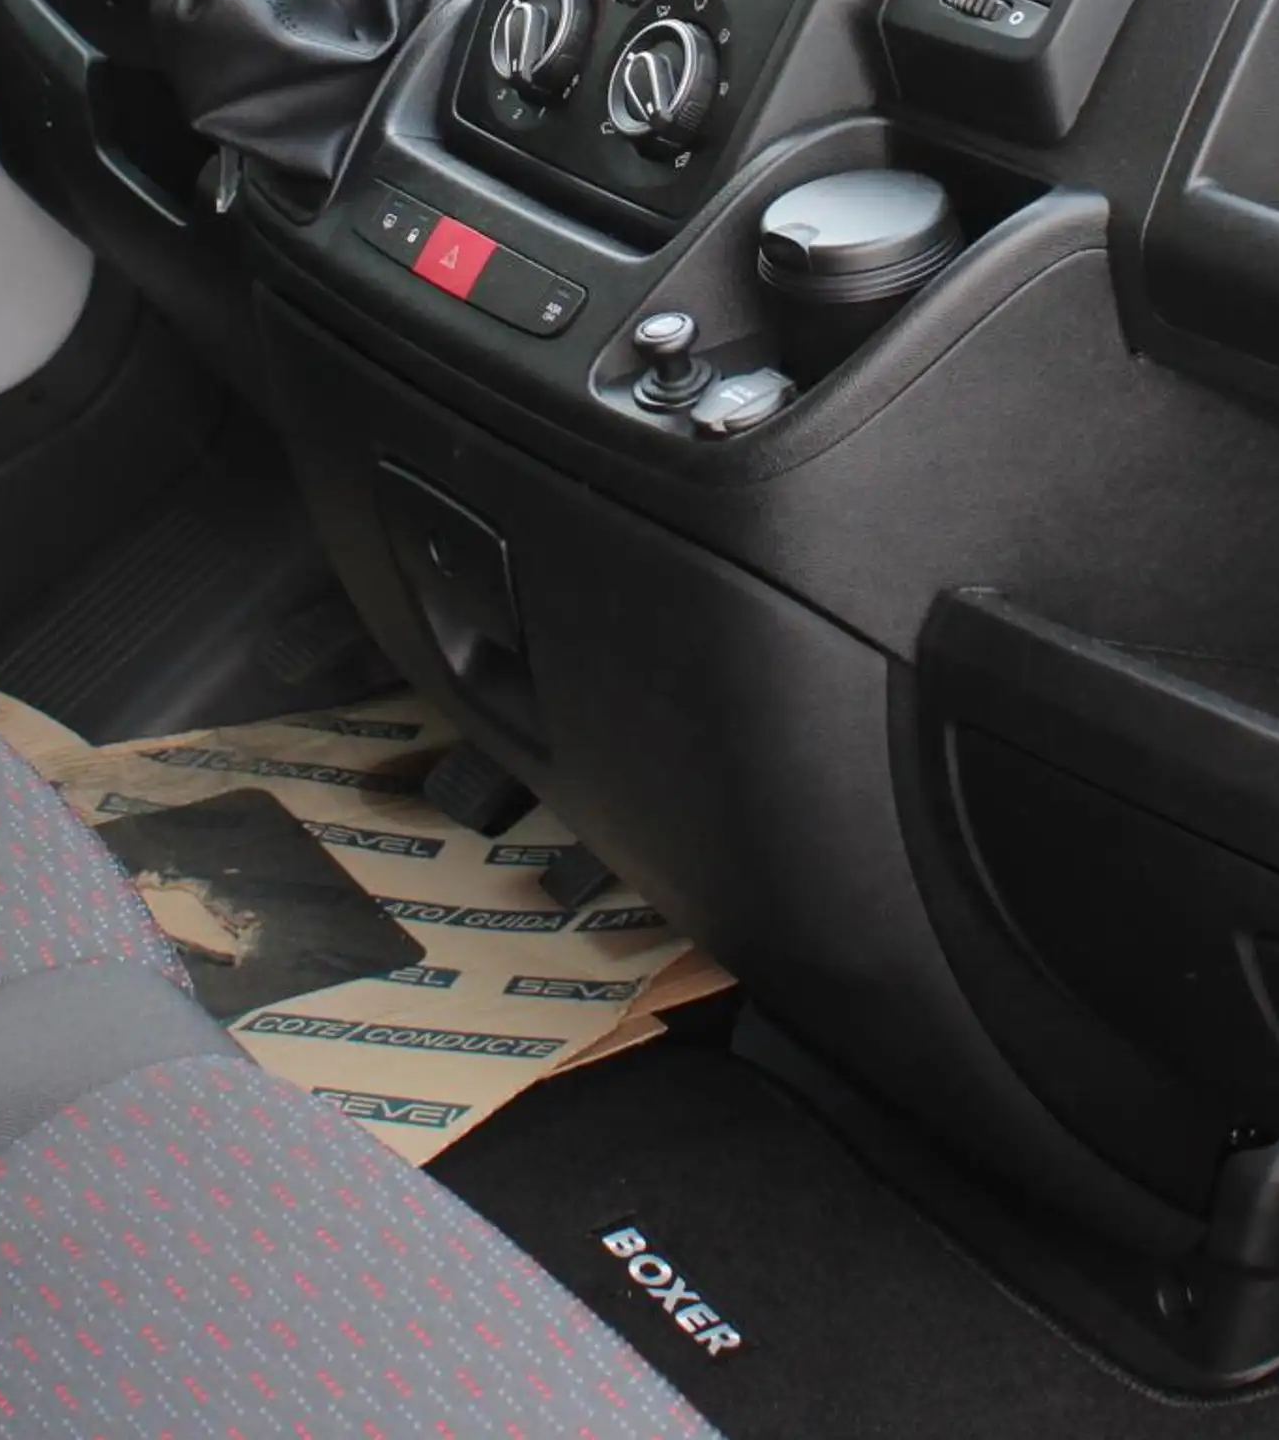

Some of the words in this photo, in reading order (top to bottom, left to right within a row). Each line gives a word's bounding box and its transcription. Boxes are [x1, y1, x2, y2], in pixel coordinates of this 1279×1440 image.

[375, 897, 447, 921] ATO
[464, 910, 564, 931] GUIDA
[252, 1015, 352, 1038] COTE
[363, 1025, 563, 1058] CONDUCTE
[602, 1226, 742, 1357] BOXER
